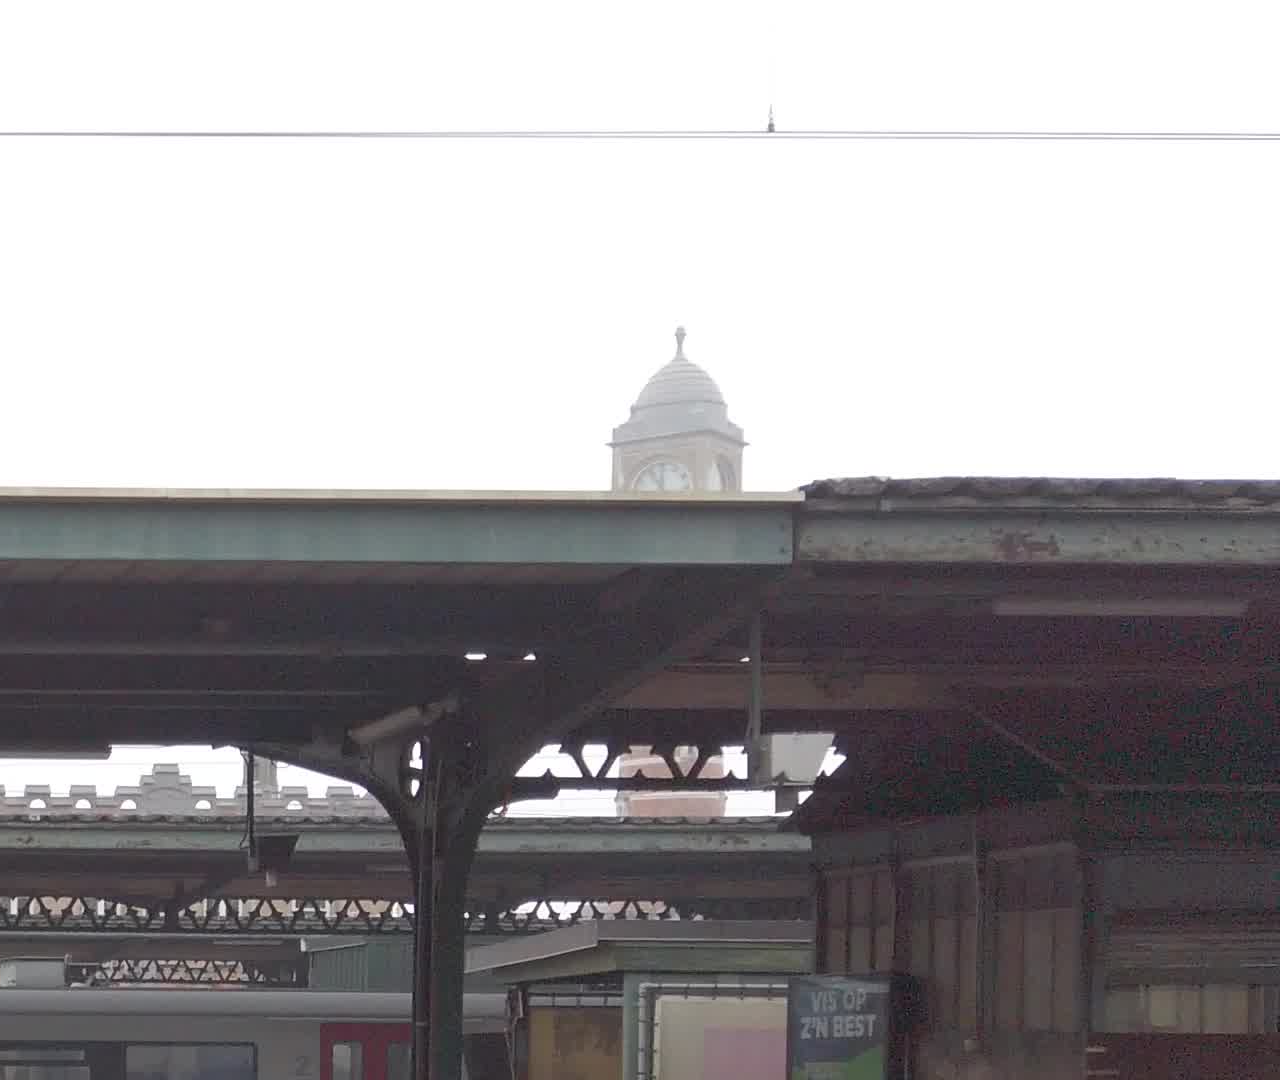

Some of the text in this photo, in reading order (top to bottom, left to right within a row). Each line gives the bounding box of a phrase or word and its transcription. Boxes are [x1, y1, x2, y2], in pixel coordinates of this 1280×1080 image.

[810, 990, 867, 1013] VIS OP
[832, 1014, 878, 1038] BEST
[295, 1055, 313, 1077] 2
